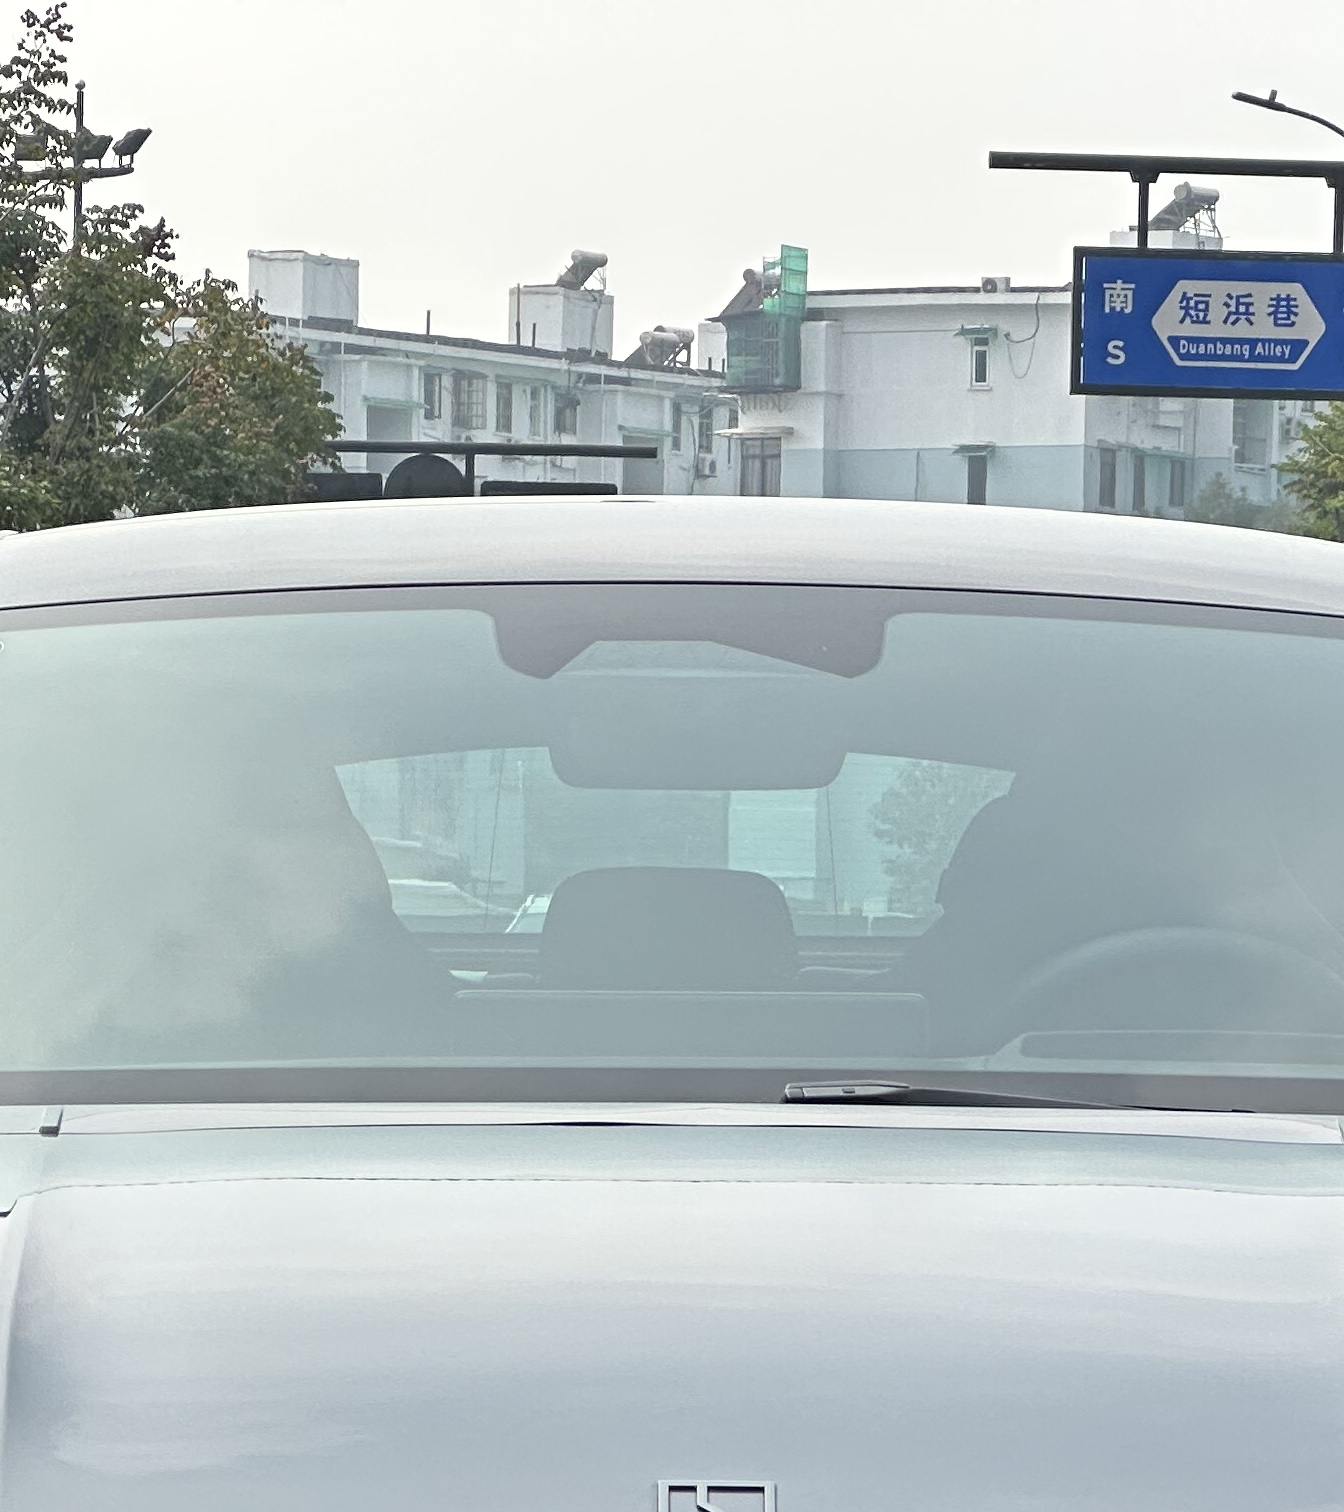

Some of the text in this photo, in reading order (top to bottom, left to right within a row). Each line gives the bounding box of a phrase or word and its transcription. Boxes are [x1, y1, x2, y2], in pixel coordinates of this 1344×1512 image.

[1103, 280, 1135, 314] 南
[1178, 291, 1299, 327] 短浜巷
[1106, 340, 1126, 365] S
[1179, 340, 1291, 359] Duanbang Alley
